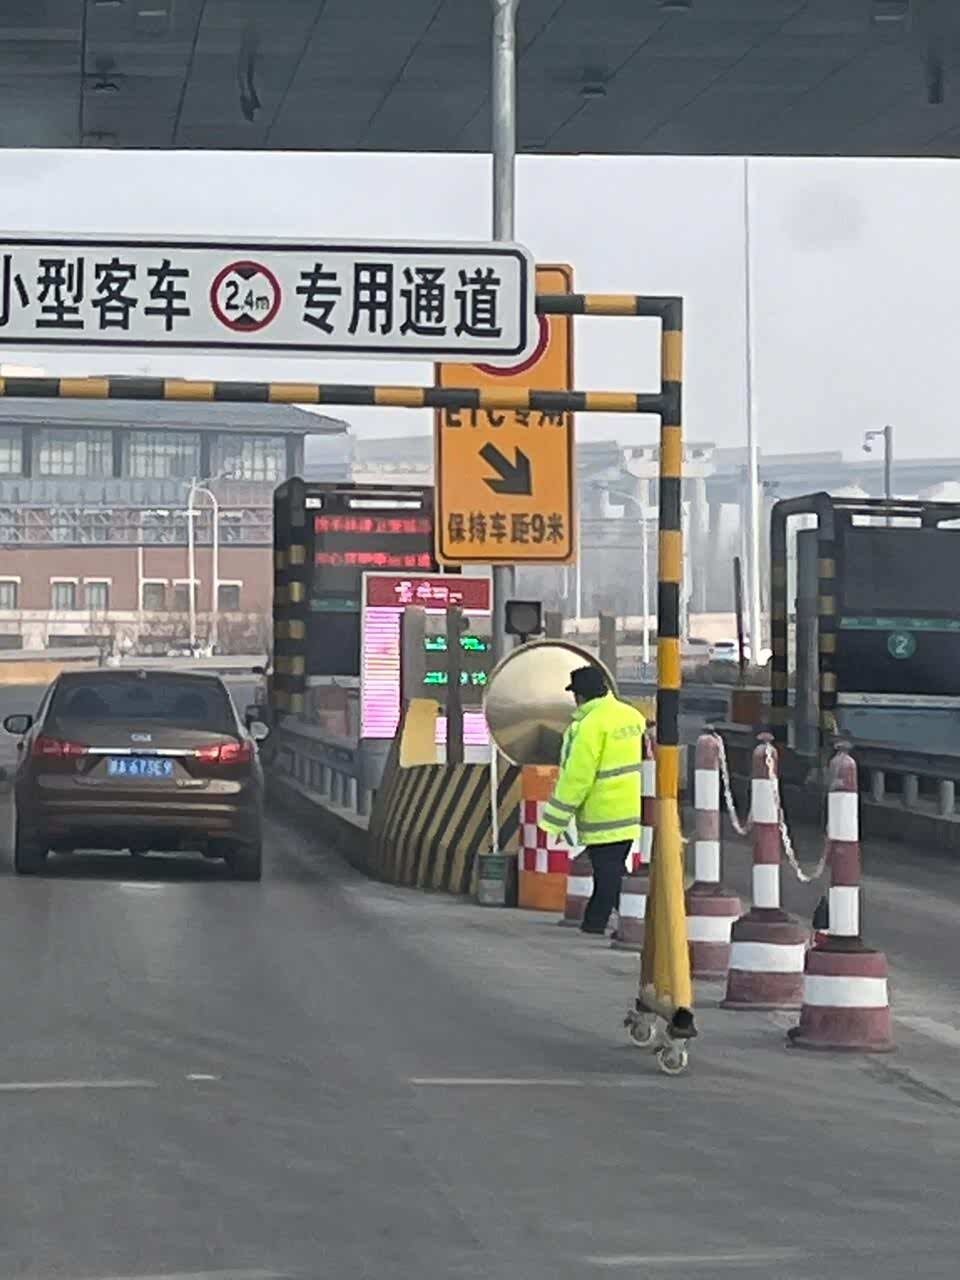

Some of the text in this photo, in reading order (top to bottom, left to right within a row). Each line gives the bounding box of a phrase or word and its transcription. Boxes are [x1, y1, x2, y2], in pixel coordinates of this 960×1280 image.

[225, 280, 270, 311] 2.4m
[296, 262, 502, 339] 专用通道
[447, 511, 565, 545] 保持车距9米
